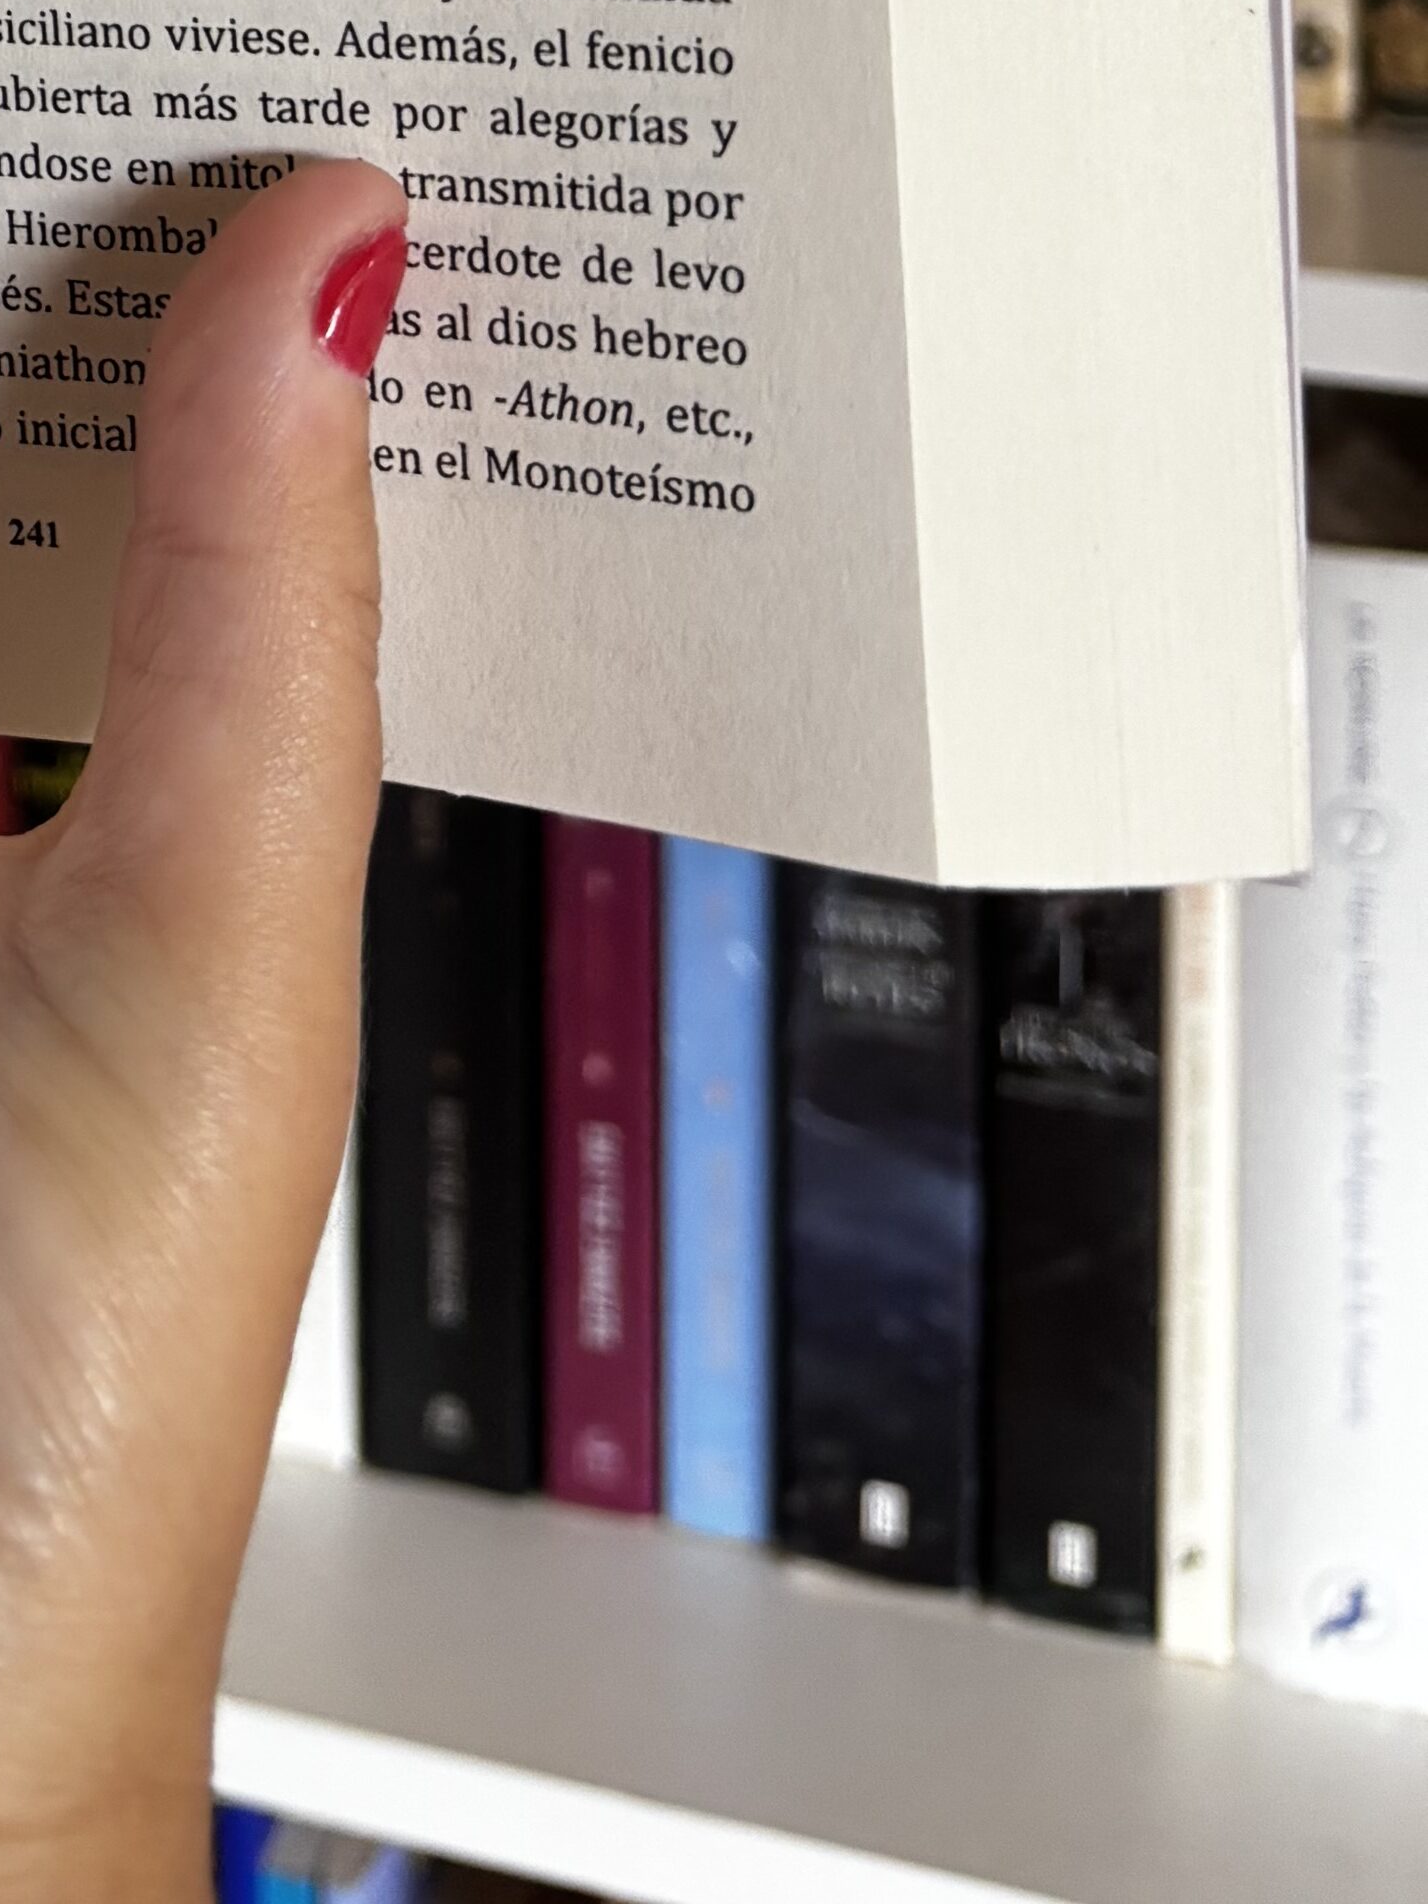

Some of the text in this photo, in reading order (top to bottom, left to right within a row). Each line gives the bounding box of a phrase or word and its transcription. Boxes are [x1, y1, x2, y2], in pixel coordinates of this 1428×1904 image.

[152, 82, 238, 122] más
[257, 87, 371, 128] tarde
[392, 102, 469, 140] por
[489, 96, 689, 150] alegorías
[710, 119, 738, 159] y
[399, 165, 745, 228] transmitida por
[436, 302, 748, 367] al dios hebreo
[7, 517, 60, 549] 241
